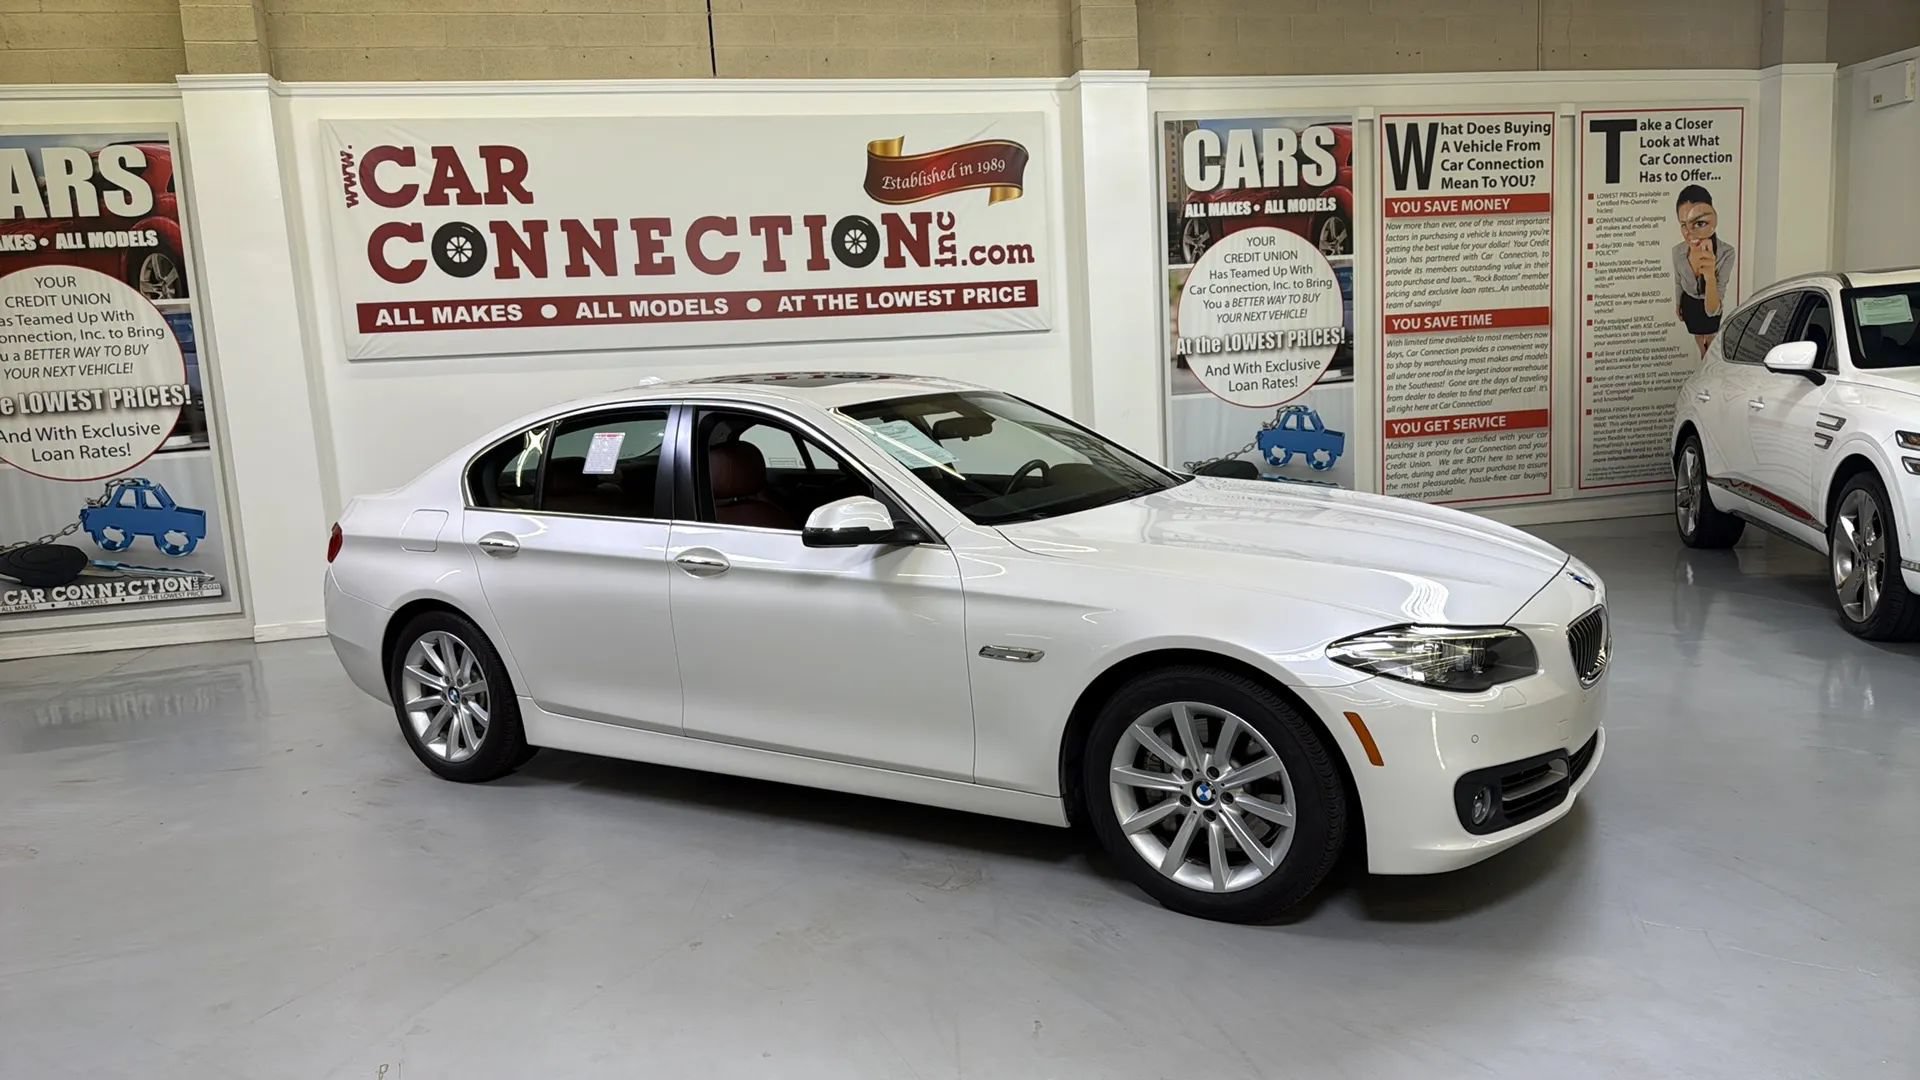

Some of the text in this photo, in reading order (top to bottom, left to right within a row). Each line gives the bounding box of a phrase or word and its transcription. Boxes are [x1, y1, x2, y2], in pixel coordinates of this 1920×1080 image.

[1467, 122, 1500, 135] Does
[1504, 121, 1551, 137] Buying
[1665, 120, 1672, 131] a
[1675, 118, 1714, 130] Closer
[1441, 139, 1540, 153] A Vehicle From
[1639, 134, 1720, 148] Look at What
[1183, 126, 1337, 191] CARS
[1441, 157, 1544, 171] Car Connection
[1639, 152, 1733, 166] Car Connection
[340, 144, 359, 208] www.
[359, 144, 534, 208] CAR
[881, 158, 1006, 190] Established in 1989
[1441, 174, 1536, 190] Mean To YOU?
[1639, 169, 1721, 183] Has to Offer...
[1185, 197, 1336, 218] ALL MAKES ALL MODELS
[1392, 198, 1511, 214] YOU SAVE MONEY
[1386, 222, 1401, 230] Now
[1423, 221, 1440, 229] than
[1459, 219, 1472, 227] one
[1473, 218, 1482, 227] of
[1482, 218, 1493, 226] the
[1497, 218, 1514, 226] most
[1515, 218, 1549, 226] important
[0, 230, 158, 251] KES ALL MODELS
[367, 211, 933, 284] CONNECTION
[1247, 236, 1276, 247] YOUR
[961, 244, 1035, 266] .com
[1224, 250, 1298, 264] CREDIT UNION
[1209, 264, 1313, 280] Has Teamed Up With
[34, 276, 77, 288] YOUR
[1189, 277, 1333, 295] Car Connection, Inc. to Bring
[5, 293, 111, 309] CREDIT UNION
[376, 285, 1026, 326] ALL MAKES ALL MODELS AT THE LOWEST PRICE
[1203, 293, 1321, 310] You a BETTER WAY TO BUY
[15, 312, 73, 326] Teamed
[77, 312, 98, 326] Up
[101, 309, 134, 322] With
[1216, 309, 1308, 324] YOUR NEXT VEHICLE!
[1392, 313, 1493, 330] YOU SAVE TIME
[80, 328, 105, 340] Inc.
[108, 327, 123, 339] to
[128, 325, 165, 340] Bring
[1387, 338, 1403, 347] With
[1404, 337, 1428, 346] limited
[1429, 337, 1444, 345] time
[1445, 335, 1476, 344] available
[1485, 334, 1502, 342] most
[1503, 332, 1533, 340] members
[1176, 327, 1345, 356] At the LOWEST PRICES!
[13, 351, 21, 361] a
[24, 348, 70, 361] BETTER
[73, 346, 102, 359] WAY
[104, 345, 122, 357] TO
[123, 343, 149, 356] BUY
[4, 362, 133, 380] YOUR NEXT VEHICLE!
[1205, 358, 1321, 377] And With Exclusive
[1228, 375, 1298, 392] Loan Rates!
[18, 389, 103, 414] LOWEST
[110, 384, 192, 409] PRICES!
[35, 425, 77, 441] With
[82, 421, 161, 439] Exclusive
[1392, 415, 1507, 435] YOU GET SERVICE
[1386, 440, 1414, 450] Making
[1435, 439, 1449, 448] you
[1467, 434, 1497, 443] satisfied
[1500, 433, 1515, 441] with
[1518, 432, 1534, 441] your
[31, 442, 131, 463] Loan Rates!
[4, 576, 193, 605] CAR CONNECTION
[15, 603, 37, 611] MAKES
[160, 591, 185, 599] LOWEST
[186, 589, 203, 598] PRICE
